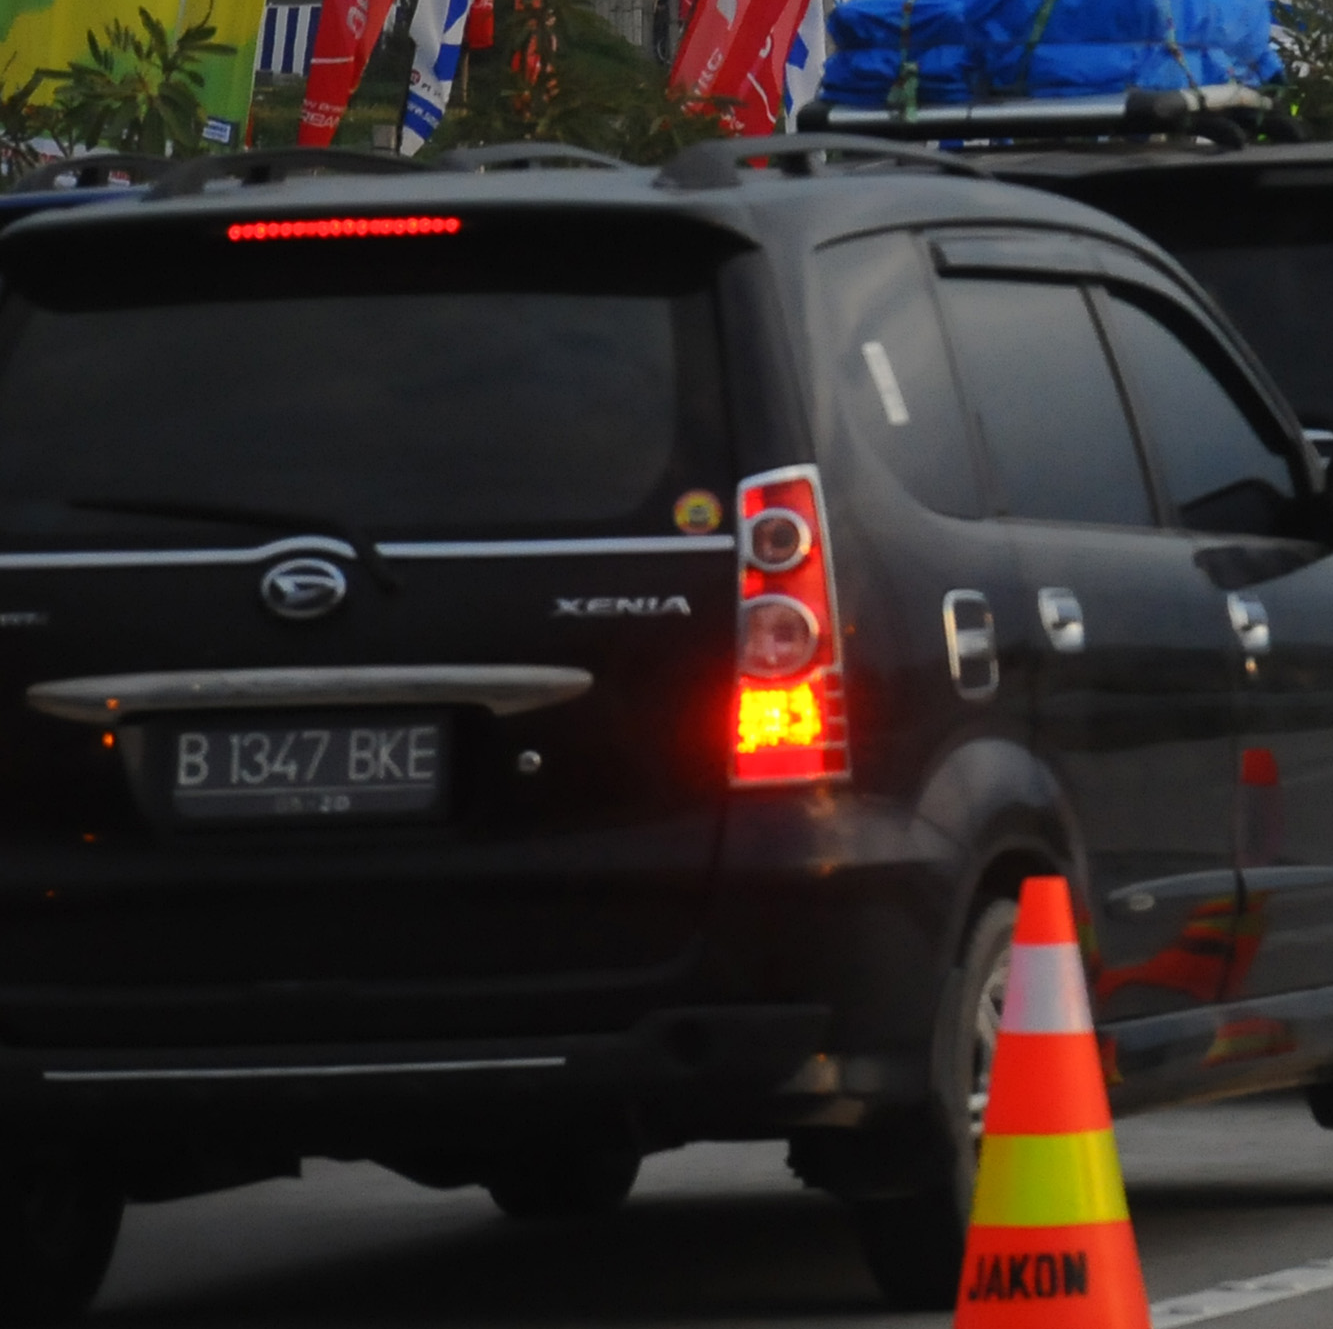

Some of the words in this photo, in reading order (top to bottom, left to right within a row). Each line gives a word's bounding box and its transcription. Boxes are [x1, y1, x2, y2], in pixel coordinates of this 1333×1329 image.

[550, 595, 692, 617] XENIA
[177, 732, 209, 786] B
[229, 729, 331, 785] 1347
[347, 725, 439, 782] BKE
[968, 1249, 1088, 1304] JAKON
